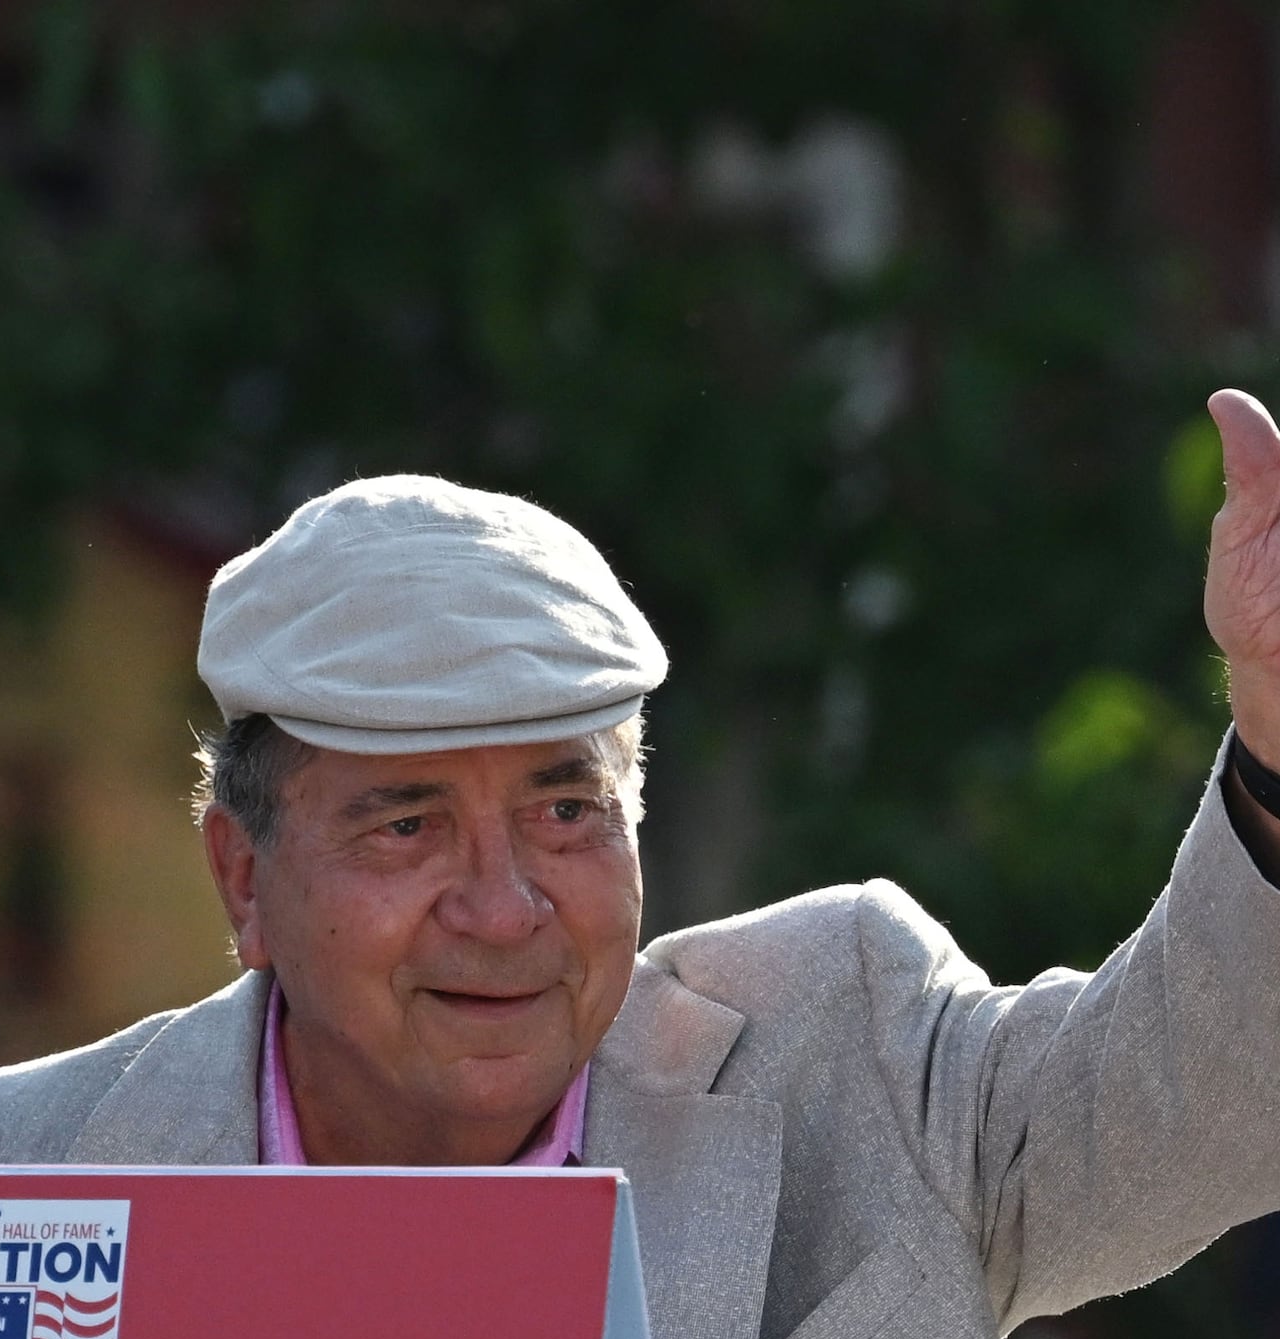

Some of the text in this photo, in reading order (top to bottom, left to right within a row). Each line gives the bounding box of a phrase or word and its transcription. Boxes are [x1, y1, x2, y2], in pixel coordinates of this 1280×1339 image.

[2, 1223, 37, 1239] HALL
[40, 1223, 60, 1239] OF
[63, 1223, 101, 1239] FAME
